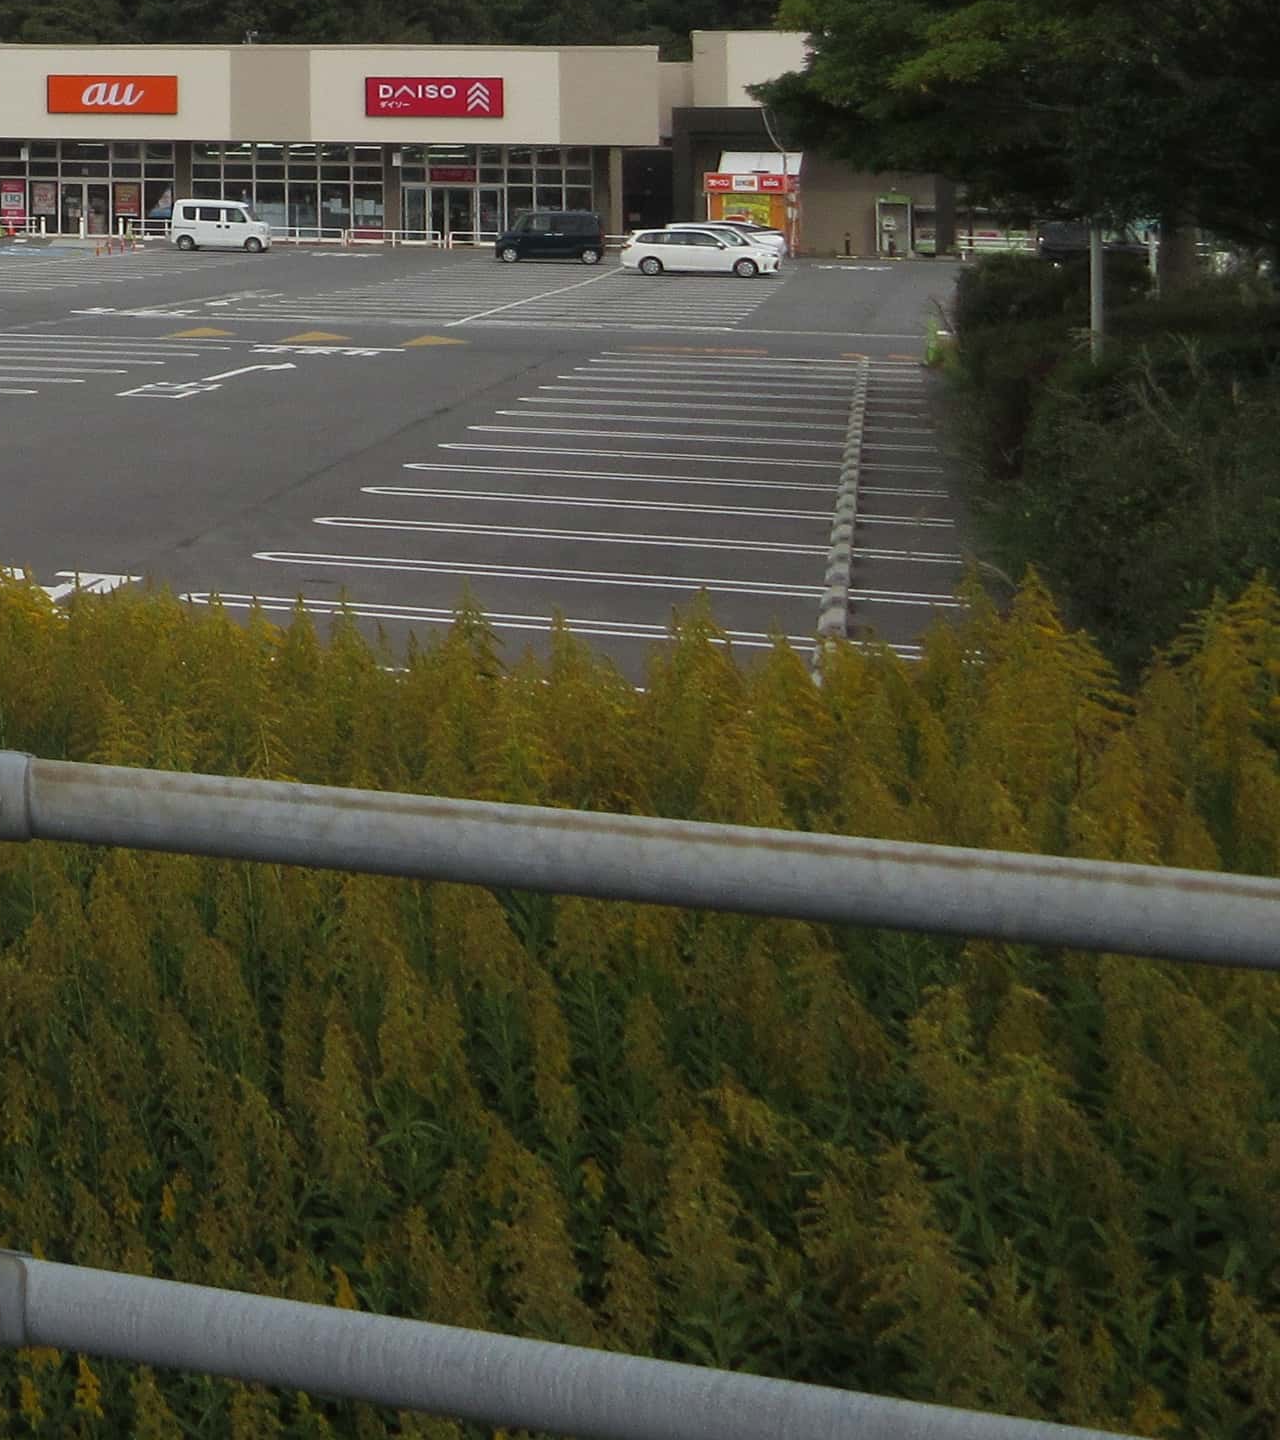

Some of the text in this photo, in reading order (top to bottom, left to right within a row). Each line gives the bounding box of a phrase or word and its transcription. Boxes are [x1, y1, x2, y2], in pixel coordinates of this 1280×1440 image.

[81, 82, 145, 106] au
[379, 84, 457, 99] DAISO
[380, 101, 411, 109] ダイソー
